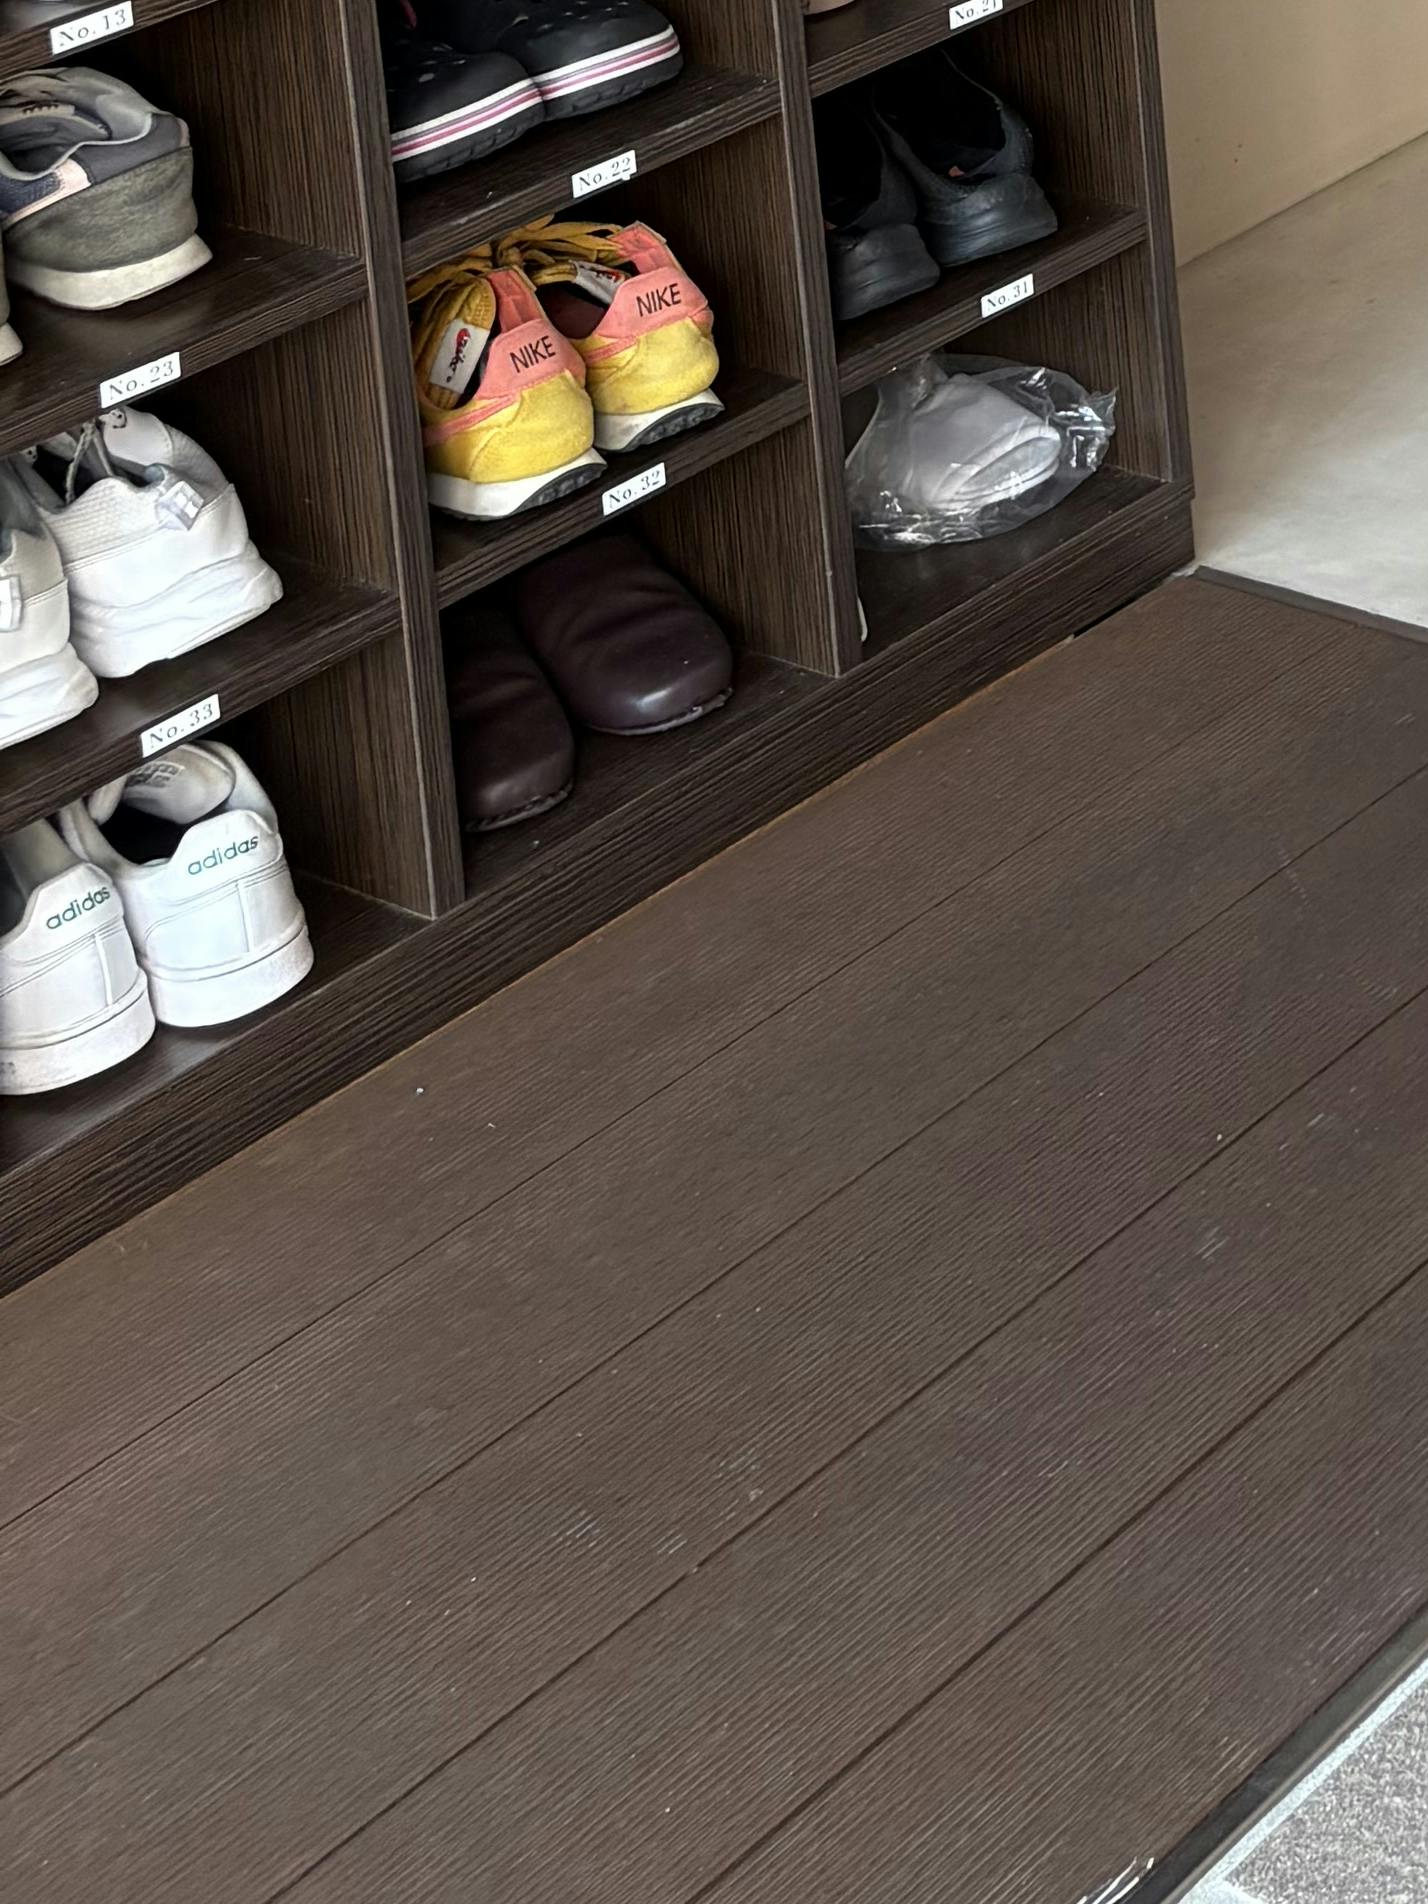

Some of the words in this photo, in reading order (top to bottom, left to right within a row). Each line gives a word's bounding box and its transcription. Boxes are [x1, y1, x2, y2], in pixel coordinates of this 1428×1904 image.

[58, 8, 127, 48] No.13
[578, 156, 632, 188] No.22
[635, 282, 682, 318] NIKE
[986, 279, 1029, 309] No.31
[509, 334, 558, 374] NIKE
[108, 359, 175, 396] No.23
[608, 469, 661, 504] No.32
[149, 702, 214, 744] No.33
[188, 833, 259, 877] adidas
[46, 885, 112, 931] adidas
